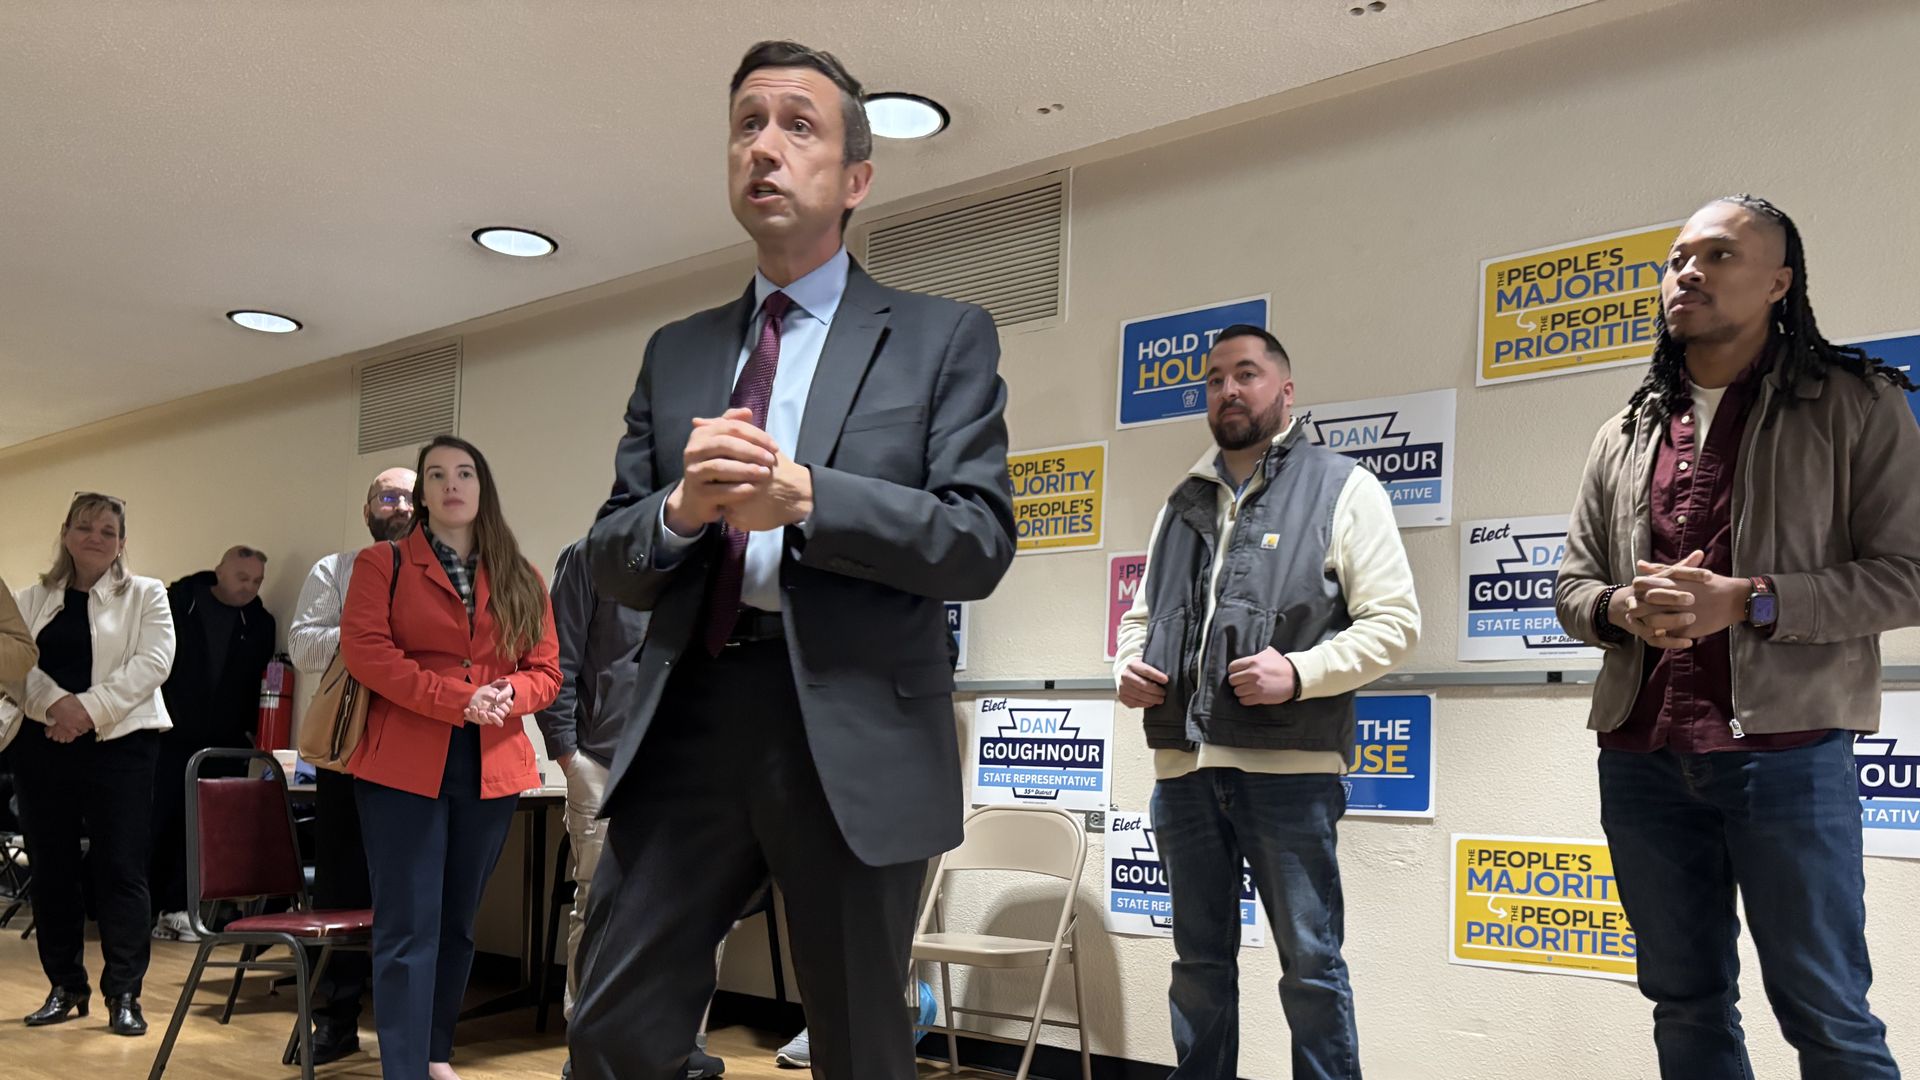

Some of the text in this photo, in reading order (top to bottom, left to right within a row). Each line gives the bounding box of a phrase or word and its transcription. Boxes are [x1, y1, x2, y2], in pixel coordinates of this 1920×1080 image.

[1507, 248, 1624, 286] PEOPLE'S
[1496, 261, 1669, 313] MAJORITY
[1497, 270, 1505, 288] THE
[1540, 315, 1548, 333] THE
[1550, 296, 1656, 331] PEOPLE'
[1138, 334, 1199, 361] HOLD
[1138, 353, 1207, 389] HOU
[1328, 425, 1379, 448] DAN
[1020, 498, 1094, 519] PEOPLE'S
[1016, 514, 1093, 538] ORITIES
[1470, 523, 1511, 545] Elect
[1531, 545, 1567, 566] DA
[1476, 618, 1521, 631] STATE
[981, 698, 1008, 713] Elect
[1019, 717, 1057, 734] DAN
[1357, 719, 1411, 741] THE
[982, 742, 1100, 762] GOUGHNOUR
[983, 772, 1097, 787] STATE REPRESENTATIVE
[1112, 817, 1142, 832] Elect
[1467, 848, 1476, 866] THE
[1478, 849, 1592, 873] PEOPLE'S
[1467, 867, 1616, 900] MAJORIT
[1117, 897, 1149, 910] STATE
[1510, 905, 1518, 923] THE
[1466, 921, 1637, 958] PRIORITIES
